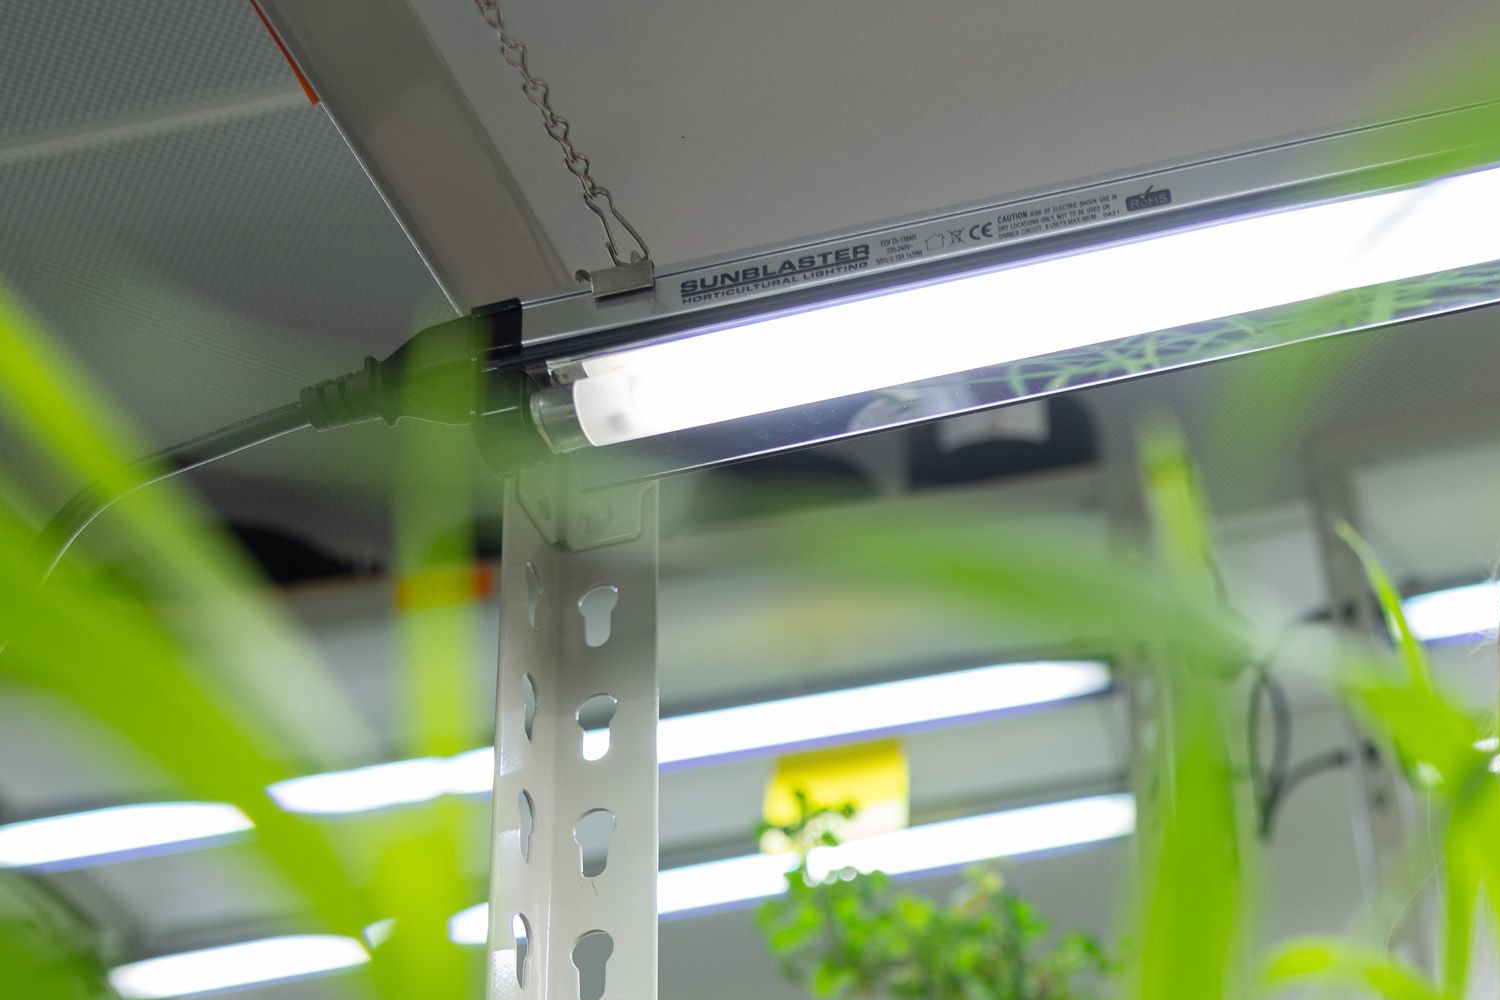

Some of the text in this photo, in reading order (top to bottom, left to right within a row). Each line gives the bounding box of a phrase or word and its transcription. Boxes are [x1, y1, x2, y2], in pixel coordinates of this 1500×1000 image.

[998, 224, 1009, 233] DRY
[1010, 218, 1040, 230] LOCATIONS
[1056, 212, 1068, 220] NOT
[1052, 202, 1078, 213] ELECTRIC
[680, 244, 869, 294] SUNBLASTER
[682, 261, 868, 305] HORTICULTURAL LIGHTING
